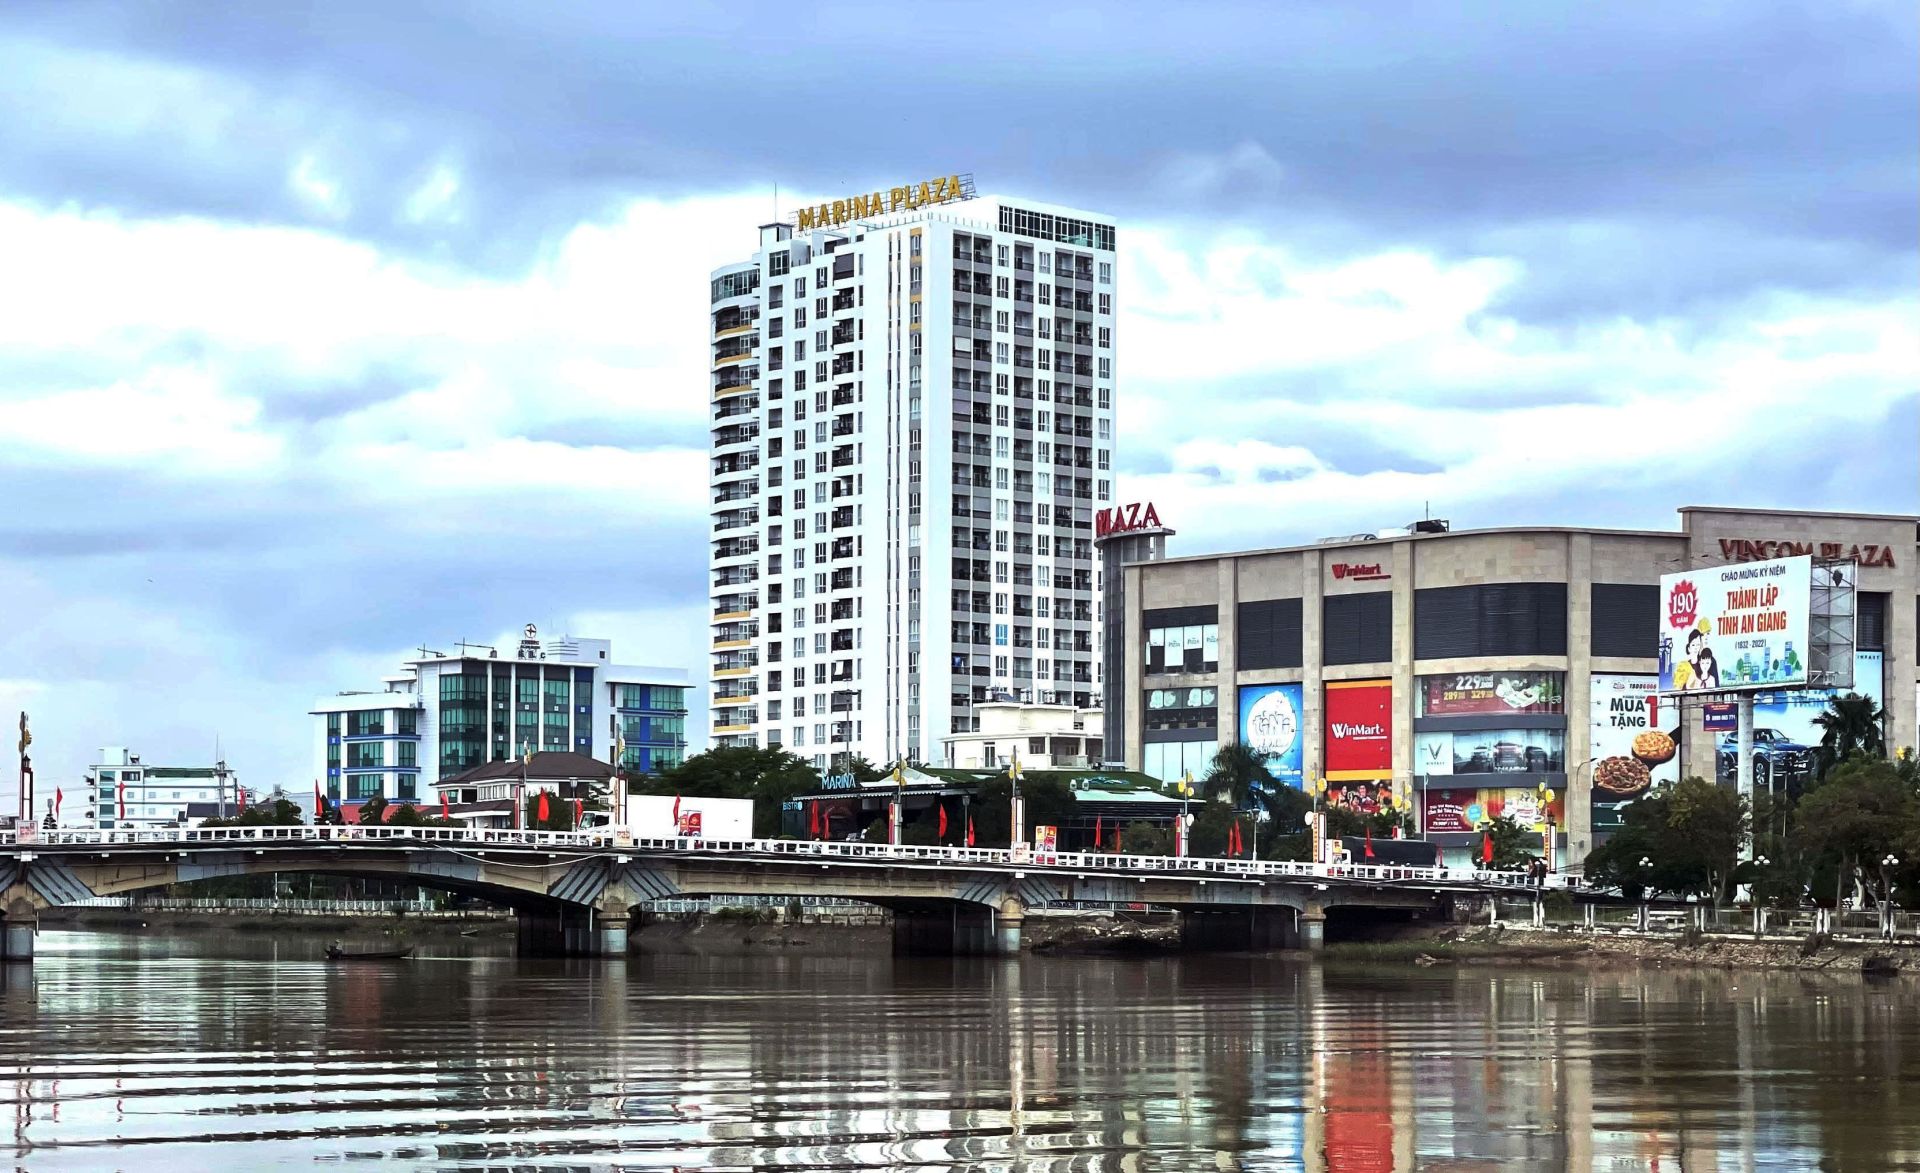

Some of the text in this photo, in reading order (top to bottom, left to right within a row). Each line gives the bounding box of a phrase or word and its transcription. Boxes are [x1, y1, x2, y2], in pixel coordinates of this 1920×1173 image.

[799, 175, 961, 232] MARINA PLAZA
[1096, 501, 1163, 537] PLAZA
[1331, 563, 1381, 579] WinMart
[1672, 592, 1693, 615] 190
[1741, 614, 1755, 634] AN
[1757, 611, 1787, 632] GIANG
[1456, 675, 1480, 690] 229
[1610, 695, 1658, 728] MUA 1
[1610, 713, 1646, 730] TẶNG
[1331, 723, 1380, 739] WinMart
[821, 772, 856, 790] MARINA
[783, 801, 803, 811] BISTRO
